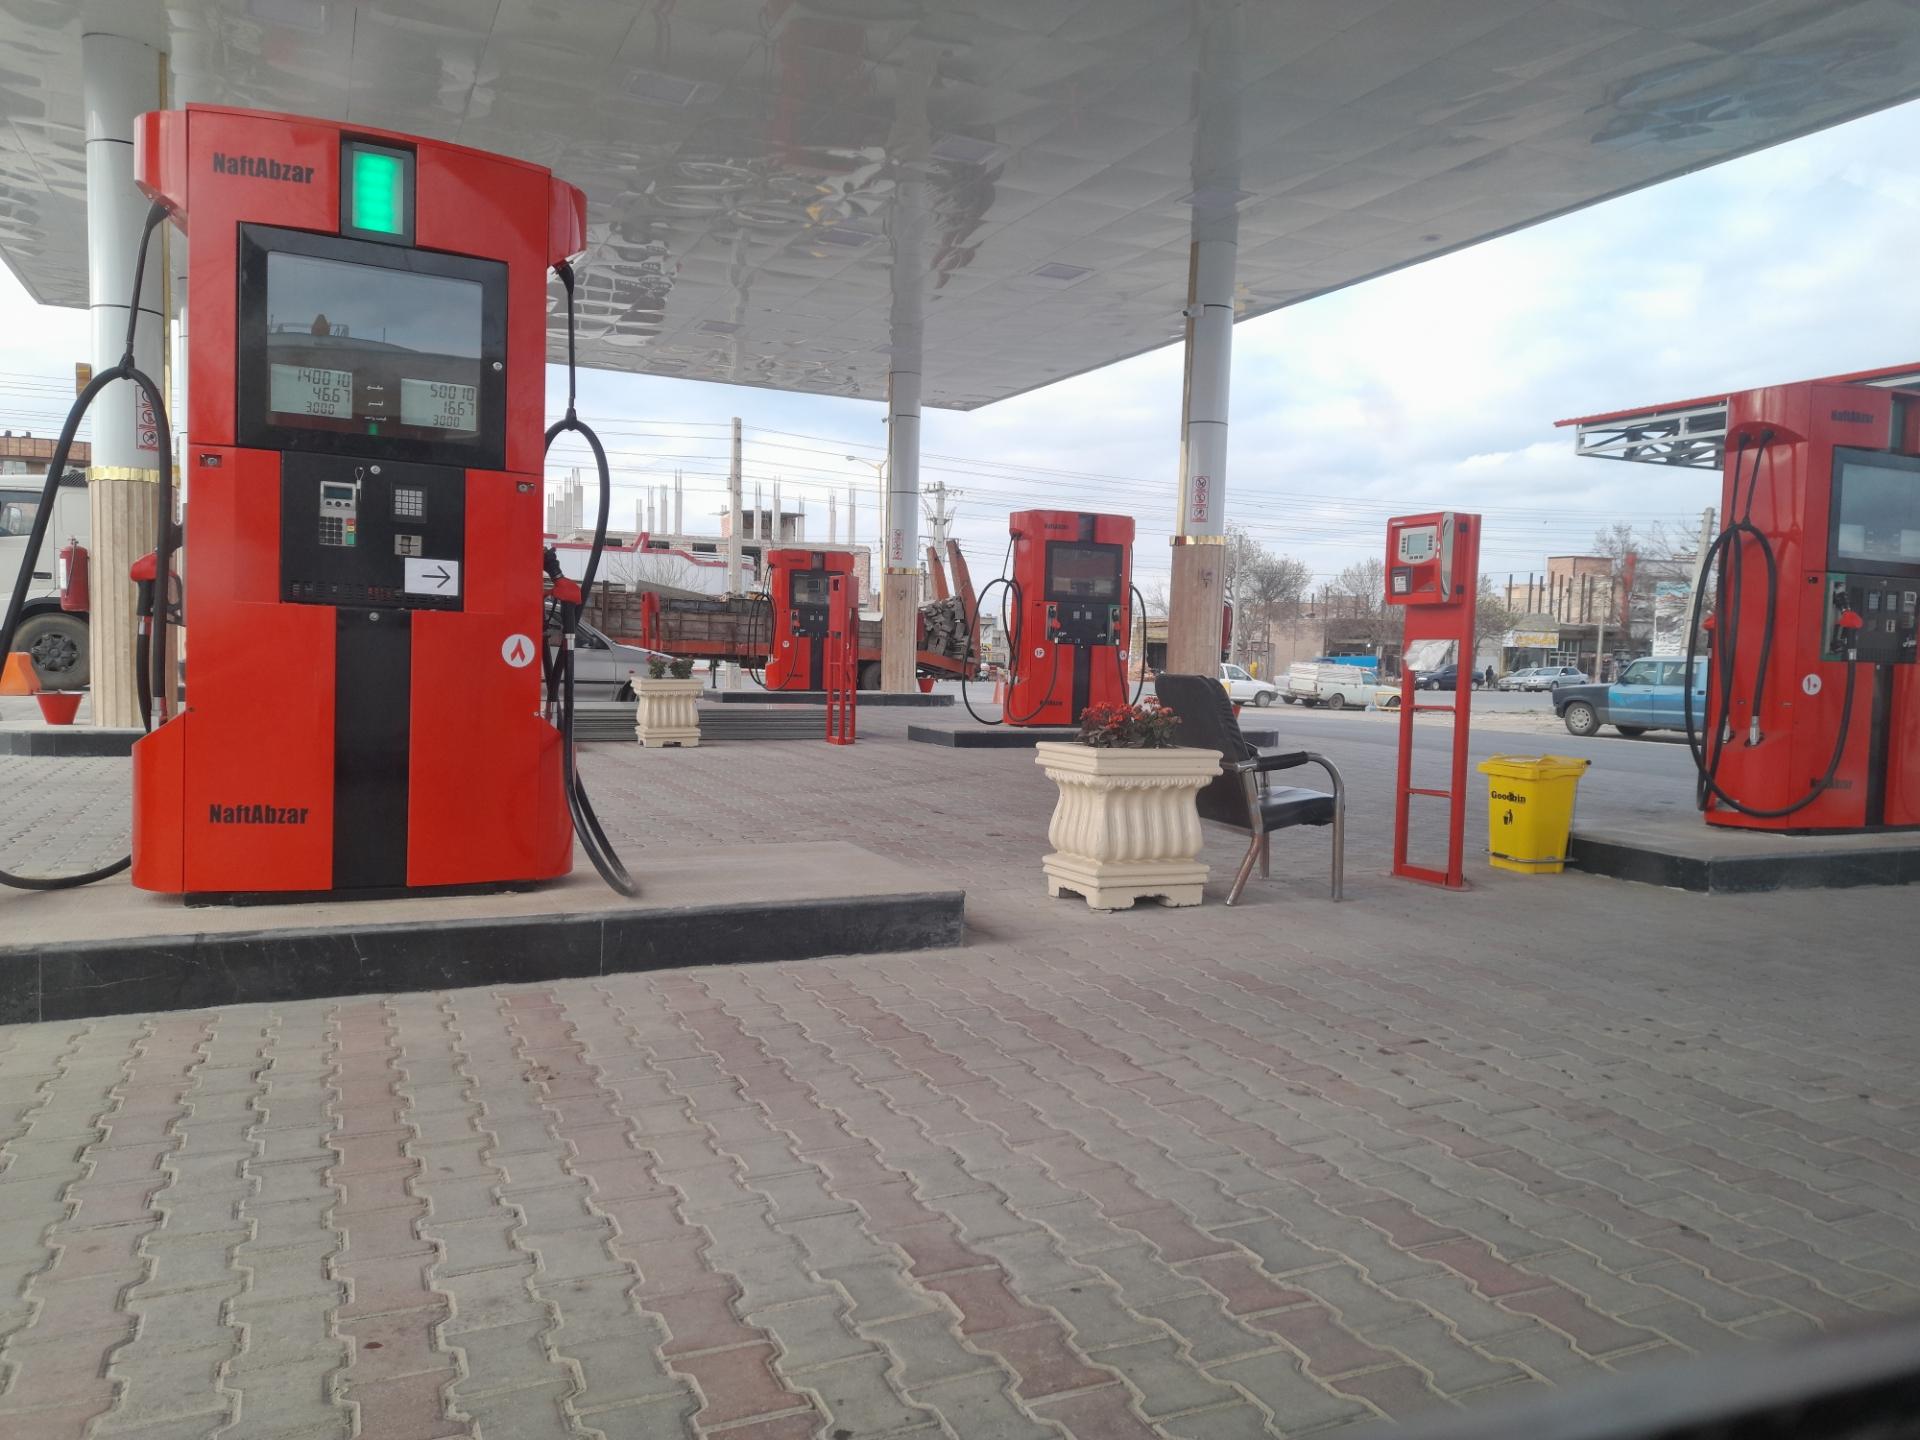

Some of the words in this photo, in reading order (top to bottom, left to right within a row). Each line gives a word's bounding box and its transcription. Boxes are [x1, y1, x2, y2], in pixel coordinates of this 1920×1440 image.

[213, 152, 315, 184] NaftAbzar
[297, 368, 351, 388] 140010
[430, 383, 475, 401] 50010
[305, 400, 336, 415] 3000
[432, 414, 460, 428] 3000
[209, 804, 309, 825] NaftAbzar
